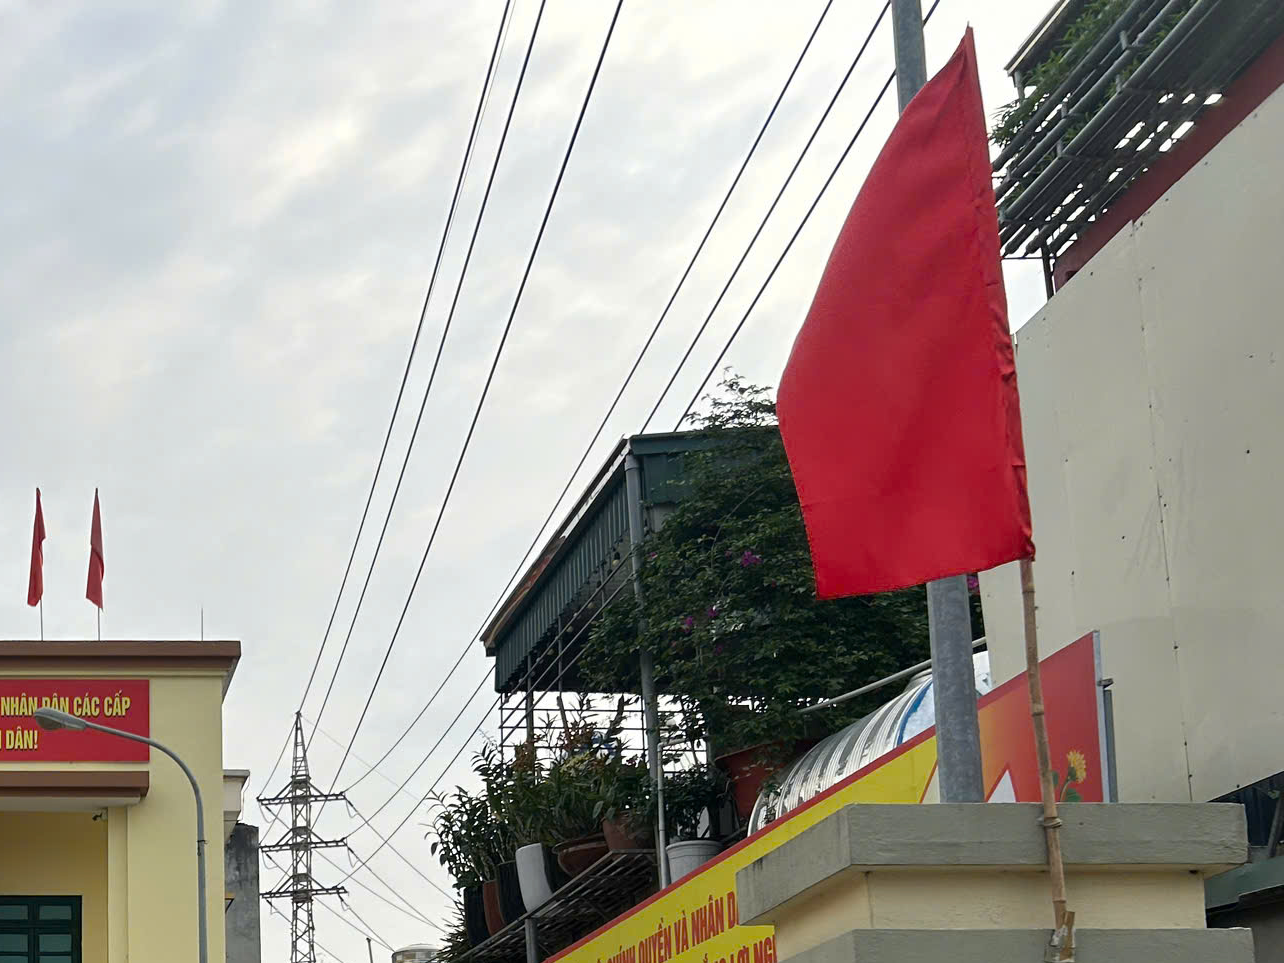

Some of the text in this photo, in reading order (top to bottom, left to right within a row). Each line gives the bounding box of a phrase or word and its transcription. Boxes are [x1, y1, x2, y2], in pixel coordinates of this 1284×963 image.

[1, 693, 37, 716] NHÂN
[73, 693, 100, 716] CÁC
[104, 690, 131, 717] CẤP
[6, 726, 38, 750] DÂN!
[674, 910, 689, 955] VÀ
[691, 895, 724, 947] NHÂN
